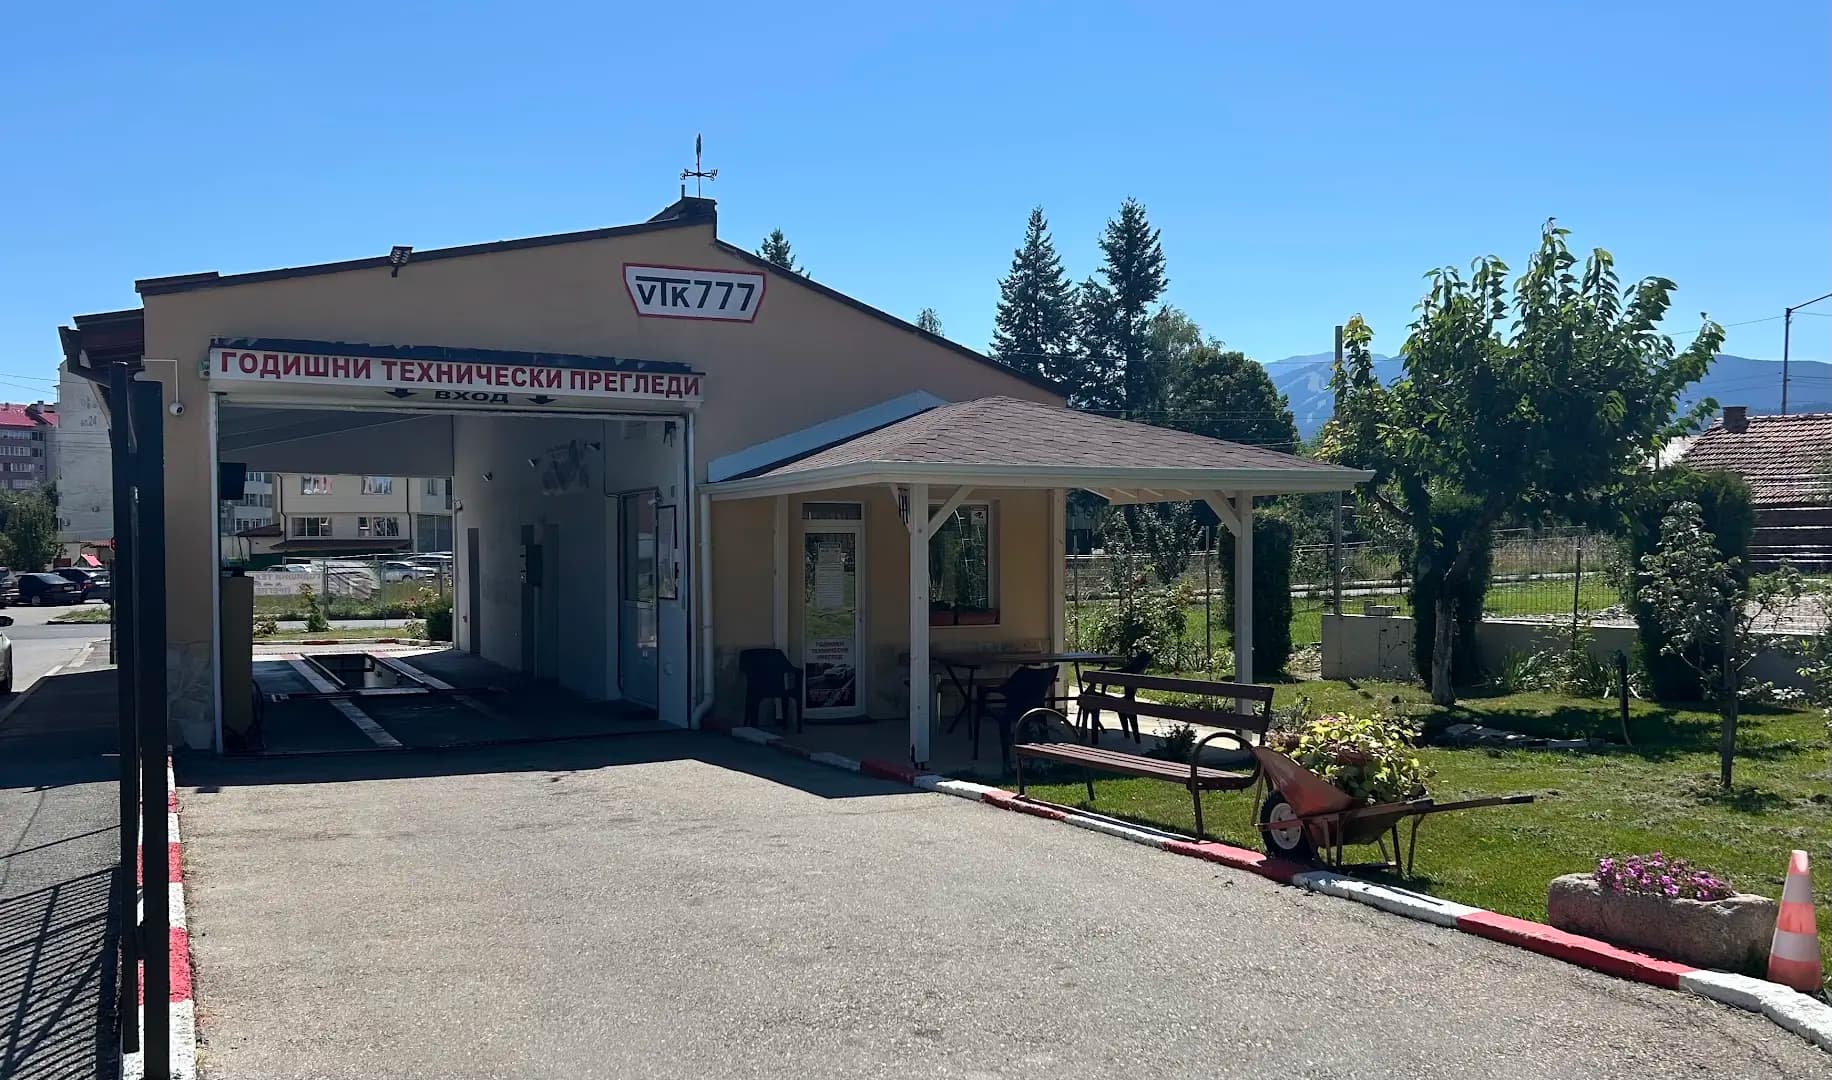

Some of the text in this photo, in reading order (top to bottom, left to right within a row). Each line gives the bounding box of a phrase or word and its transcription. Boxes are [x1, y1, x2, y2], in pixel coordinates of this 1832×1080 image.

[635, 275, 755, 311] VTK777
[221, 351, 699, 399] ГОДИШНИ ТЕХНИЧЕСКИ ПРЕГЛЕДИ
[435, 390, 509, 404] ВХОД
